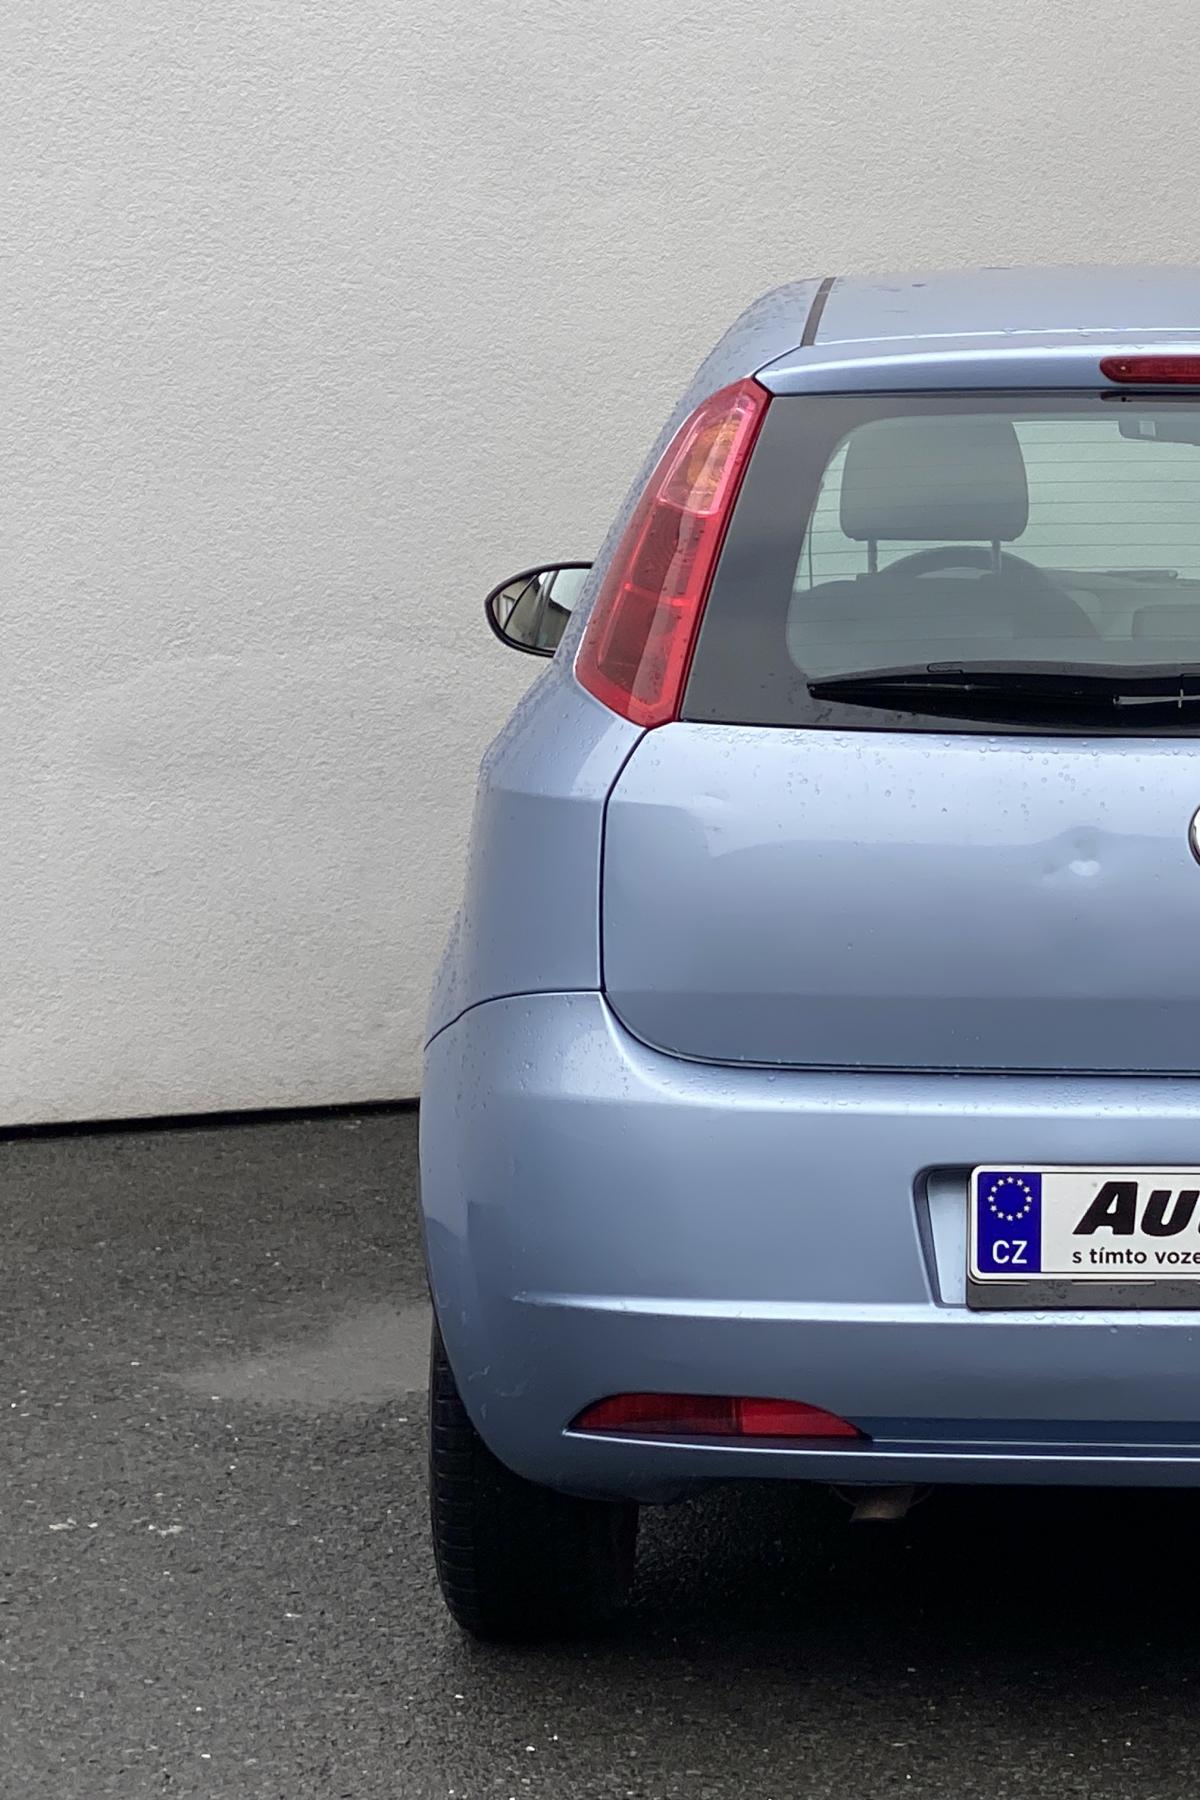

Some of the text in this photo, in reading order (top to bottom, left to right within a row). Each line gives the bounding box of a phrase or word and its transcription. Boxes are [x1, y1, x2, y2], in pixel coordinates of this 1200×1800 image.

[992, 1239, 1029, 1265] CZ
[1072, 1251, 1082, 1264] s
[1089, 1247, 1148, 1265] tímto
